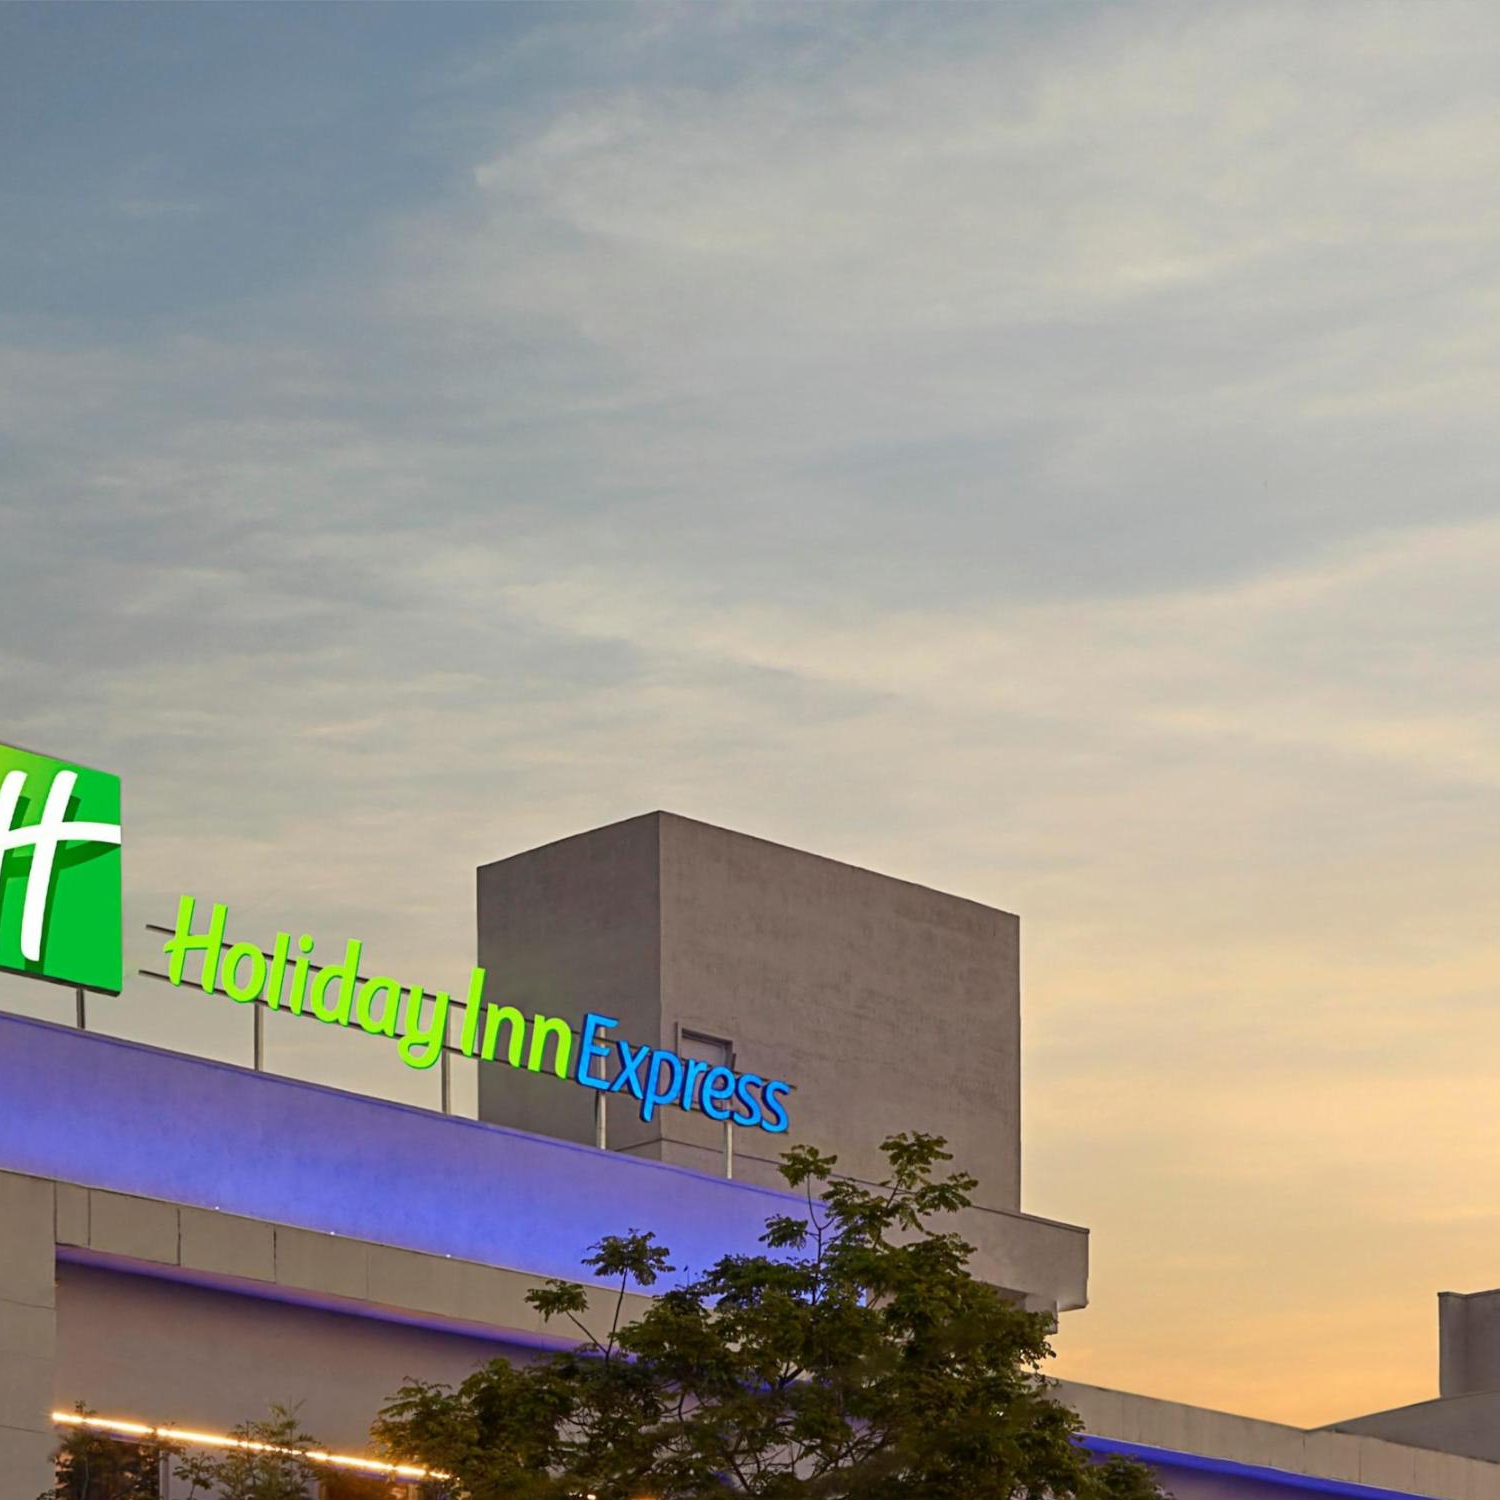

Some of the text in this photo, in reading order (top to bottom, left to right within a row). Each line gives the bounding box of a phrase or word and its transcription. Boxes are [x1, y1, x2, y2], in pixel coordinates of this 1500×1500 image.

[163, 894, 791, 1134] Holiday Inn Express
